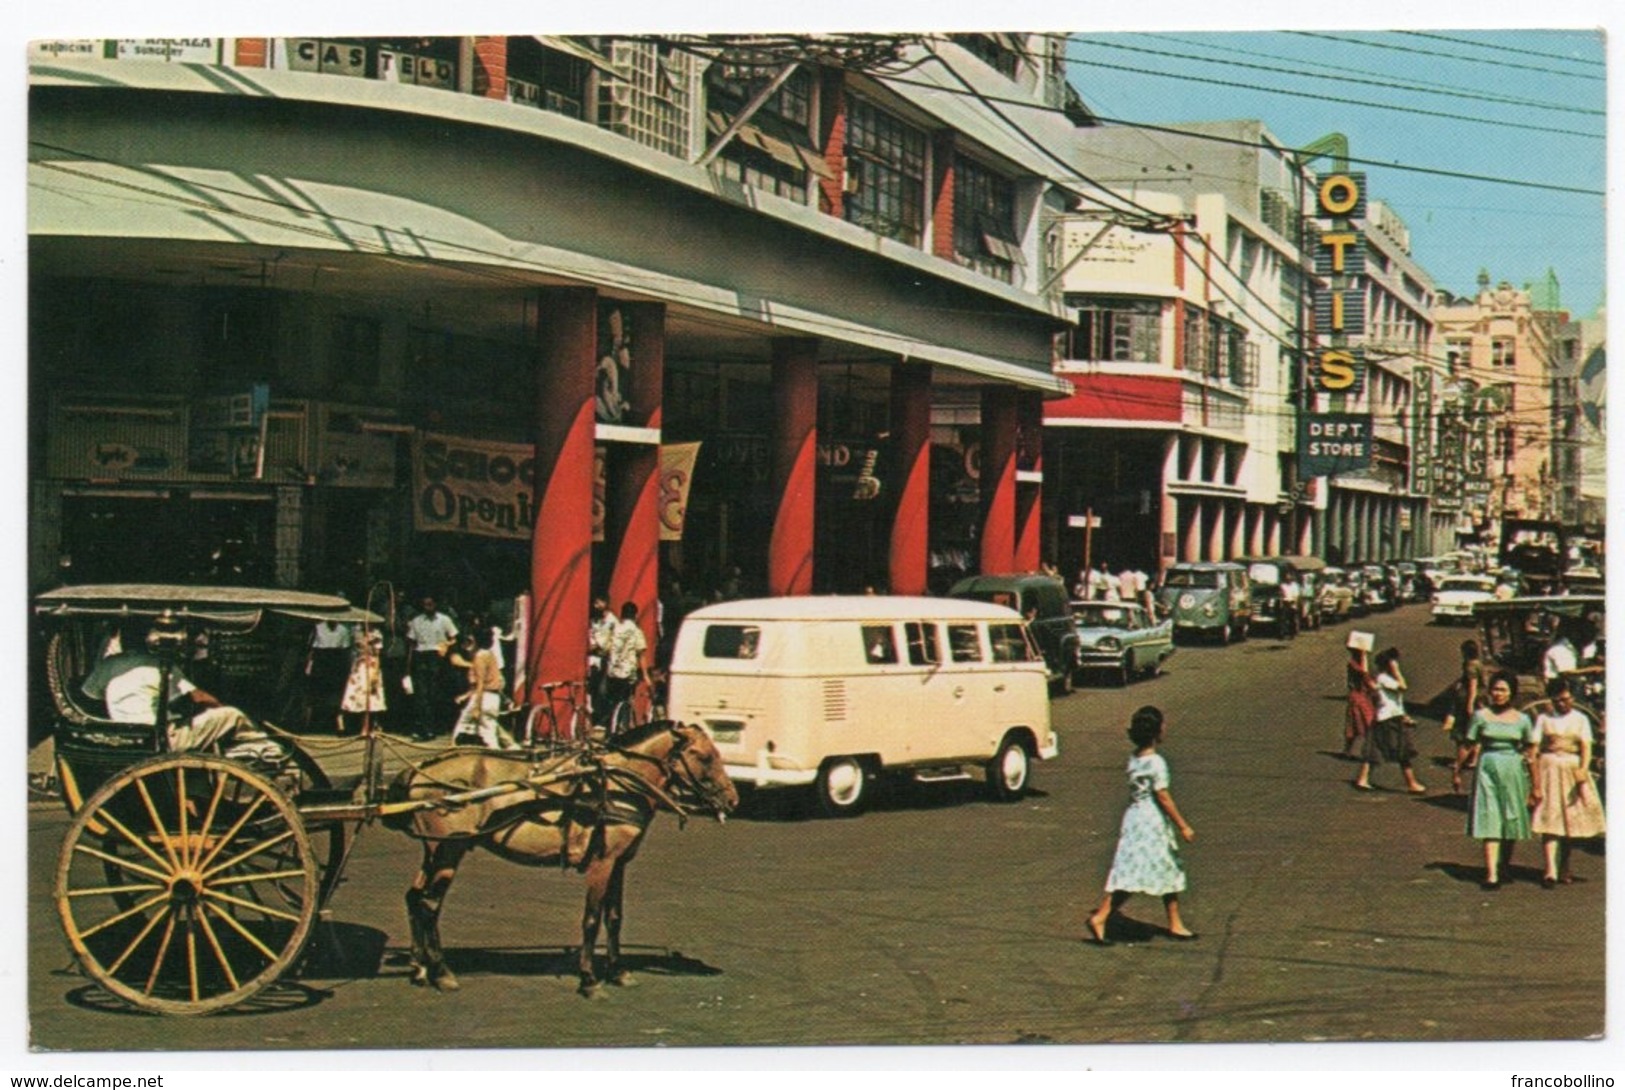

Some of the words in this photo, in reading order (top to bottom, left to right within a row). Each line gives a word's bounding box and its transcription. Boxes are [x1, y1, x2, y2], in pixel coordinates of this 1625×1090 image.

[40, 44, 93, 53] MEDICINE
[134, 45, 184, 57] SURGERY
[298, 41, 451, 78] CASTELO
[1319, 174, 1359, 389] OTIS
[1309, 442, 1364, 457] STORE
